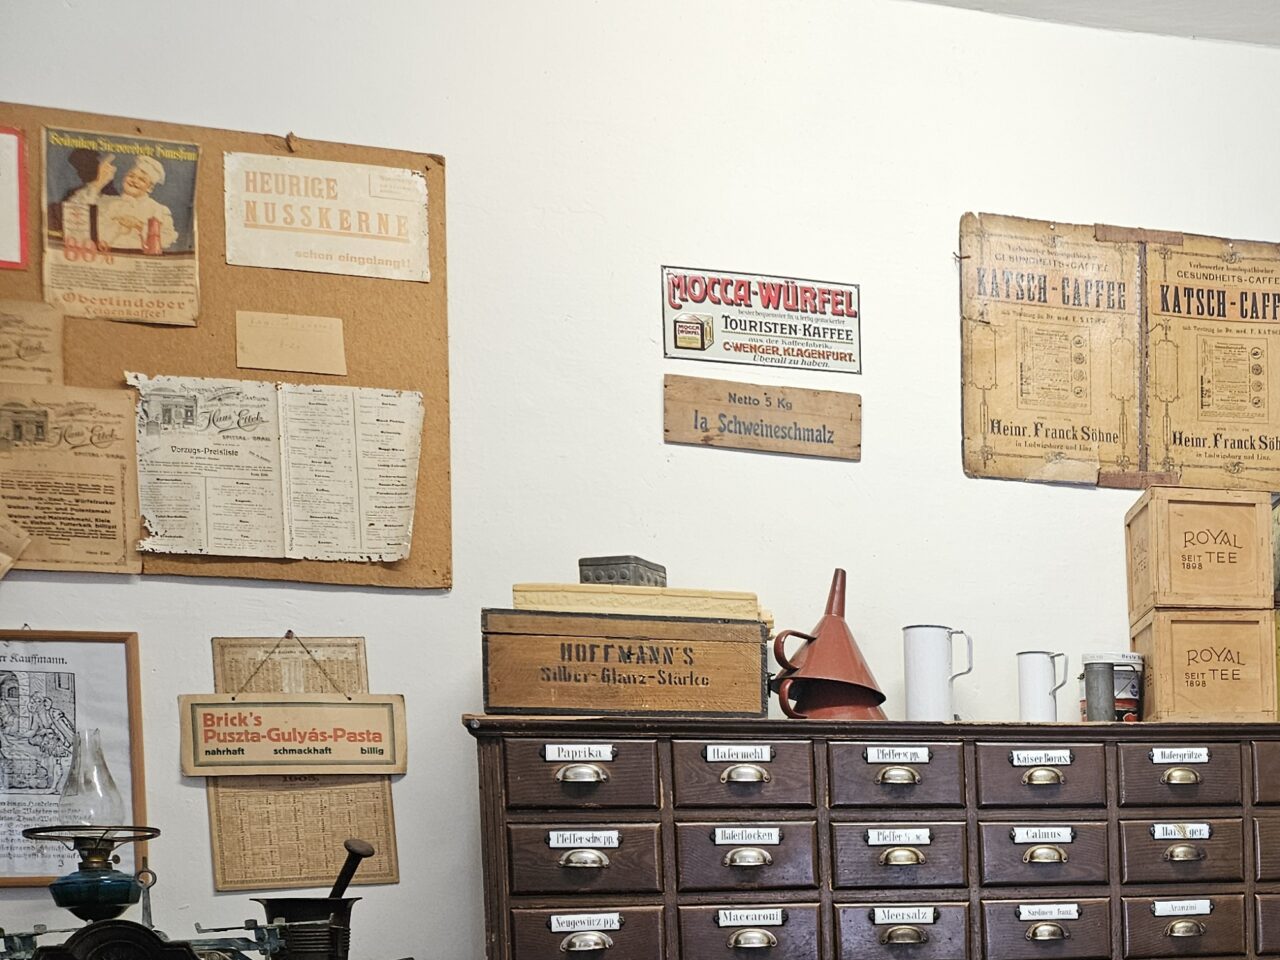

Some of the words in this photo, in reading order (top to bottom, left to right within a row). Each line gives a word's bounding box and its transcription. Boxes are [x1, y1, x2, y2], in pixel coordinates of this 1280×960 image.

[244, 170, 338, 200] HEURIGE
[244, 201, 410, 237] NUSSKERNE
[294, 249, 334, 262] schon
[666, 271, 858, 319] MOCCA-WÜRFEL
[721, 314, 854, 341] TOURISTEN-KAFFEE
[783, 346, 856, 363] KLAGENFURT.
[801, 358, 830, 368] haben.
[728, 392, 760, 406] Netto
[765, 397, 772, 408] 5
[777, 398, 793, 410] Kg
[718, 412, 835, 445] Schweineschmalz
[990, 418, 1031, 437] Heinr.
[1033, 421, 1079, 441] Franck
[1080, 423, 1120, 444] Söhne
[1172, 430, 1212, 448] Heinr.
[1213, 433, 1257, 450] Franck
[171, 446, 239, 457] Vorzugs-Preisliste
[1183, 529, 1243, 549] ROYAL
[1181, 554, 1202, 562] SEIT
[1205, 551, 1238, 563] TEE
[1182, 562, 1203, 570] 1898
[559, 641, 695, 666] HOFFMANN'S
[1187, 646, 1246, 666] ROYAL
[1184, 672, 1206, 680] SEIT
[1208, 669, 1241, 681] TEE
[1185, 680, 1207, 688] 1898
[202, 711, 263, 729] Brick's
[203, 727, 383, 745] Puszta-Gulyás-Pasta
[204, 746, 245, 756] nahrhaft
[273, 746, 332, 756] schmackhaft
[360, 746, 384, 757] billig
[557, 746, 602, 759] Paprika
[712, 746, 764, 760] Hafermehl
[1016, 751, 1043, 764] Kaiser
[1044, 751, 1068, 764] Borax
[1160, 747, 1203, 762] Hafergrütze
[721, 830, 773, 842] Haferflocken
[1026, 828, 1062, 839] Calmus
[722, 911, 778, 922] Maccaroni
[881, 909, 927, 920] Meersalz
[555, 916, 602, 929] Neugewürz
